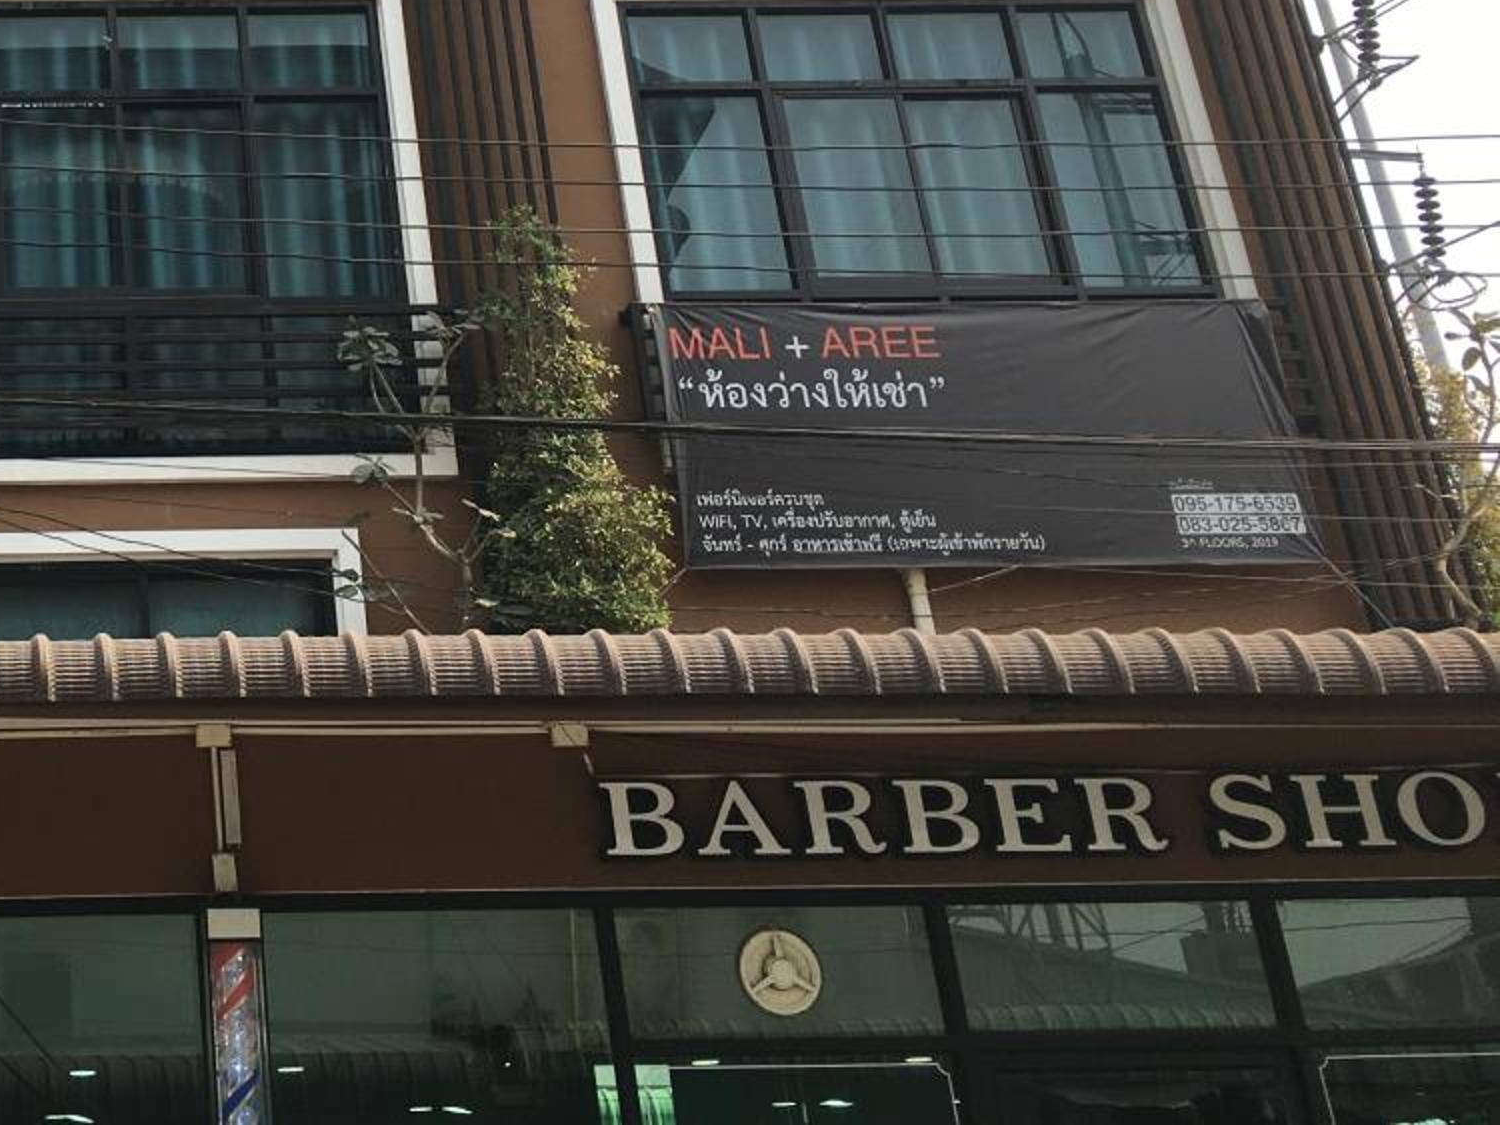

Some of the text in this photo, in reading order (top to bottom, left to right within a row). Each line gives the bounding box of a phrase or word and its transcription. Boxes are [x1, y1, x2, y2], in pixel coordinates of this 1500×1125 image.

[668, 326, 941, 359] MALI + AREE
[1174, 495, 1297, 511] 095-175-6539
[741, 514, 768, 530] TV,
[600, 771, 1500, 857] BARBER SHO
